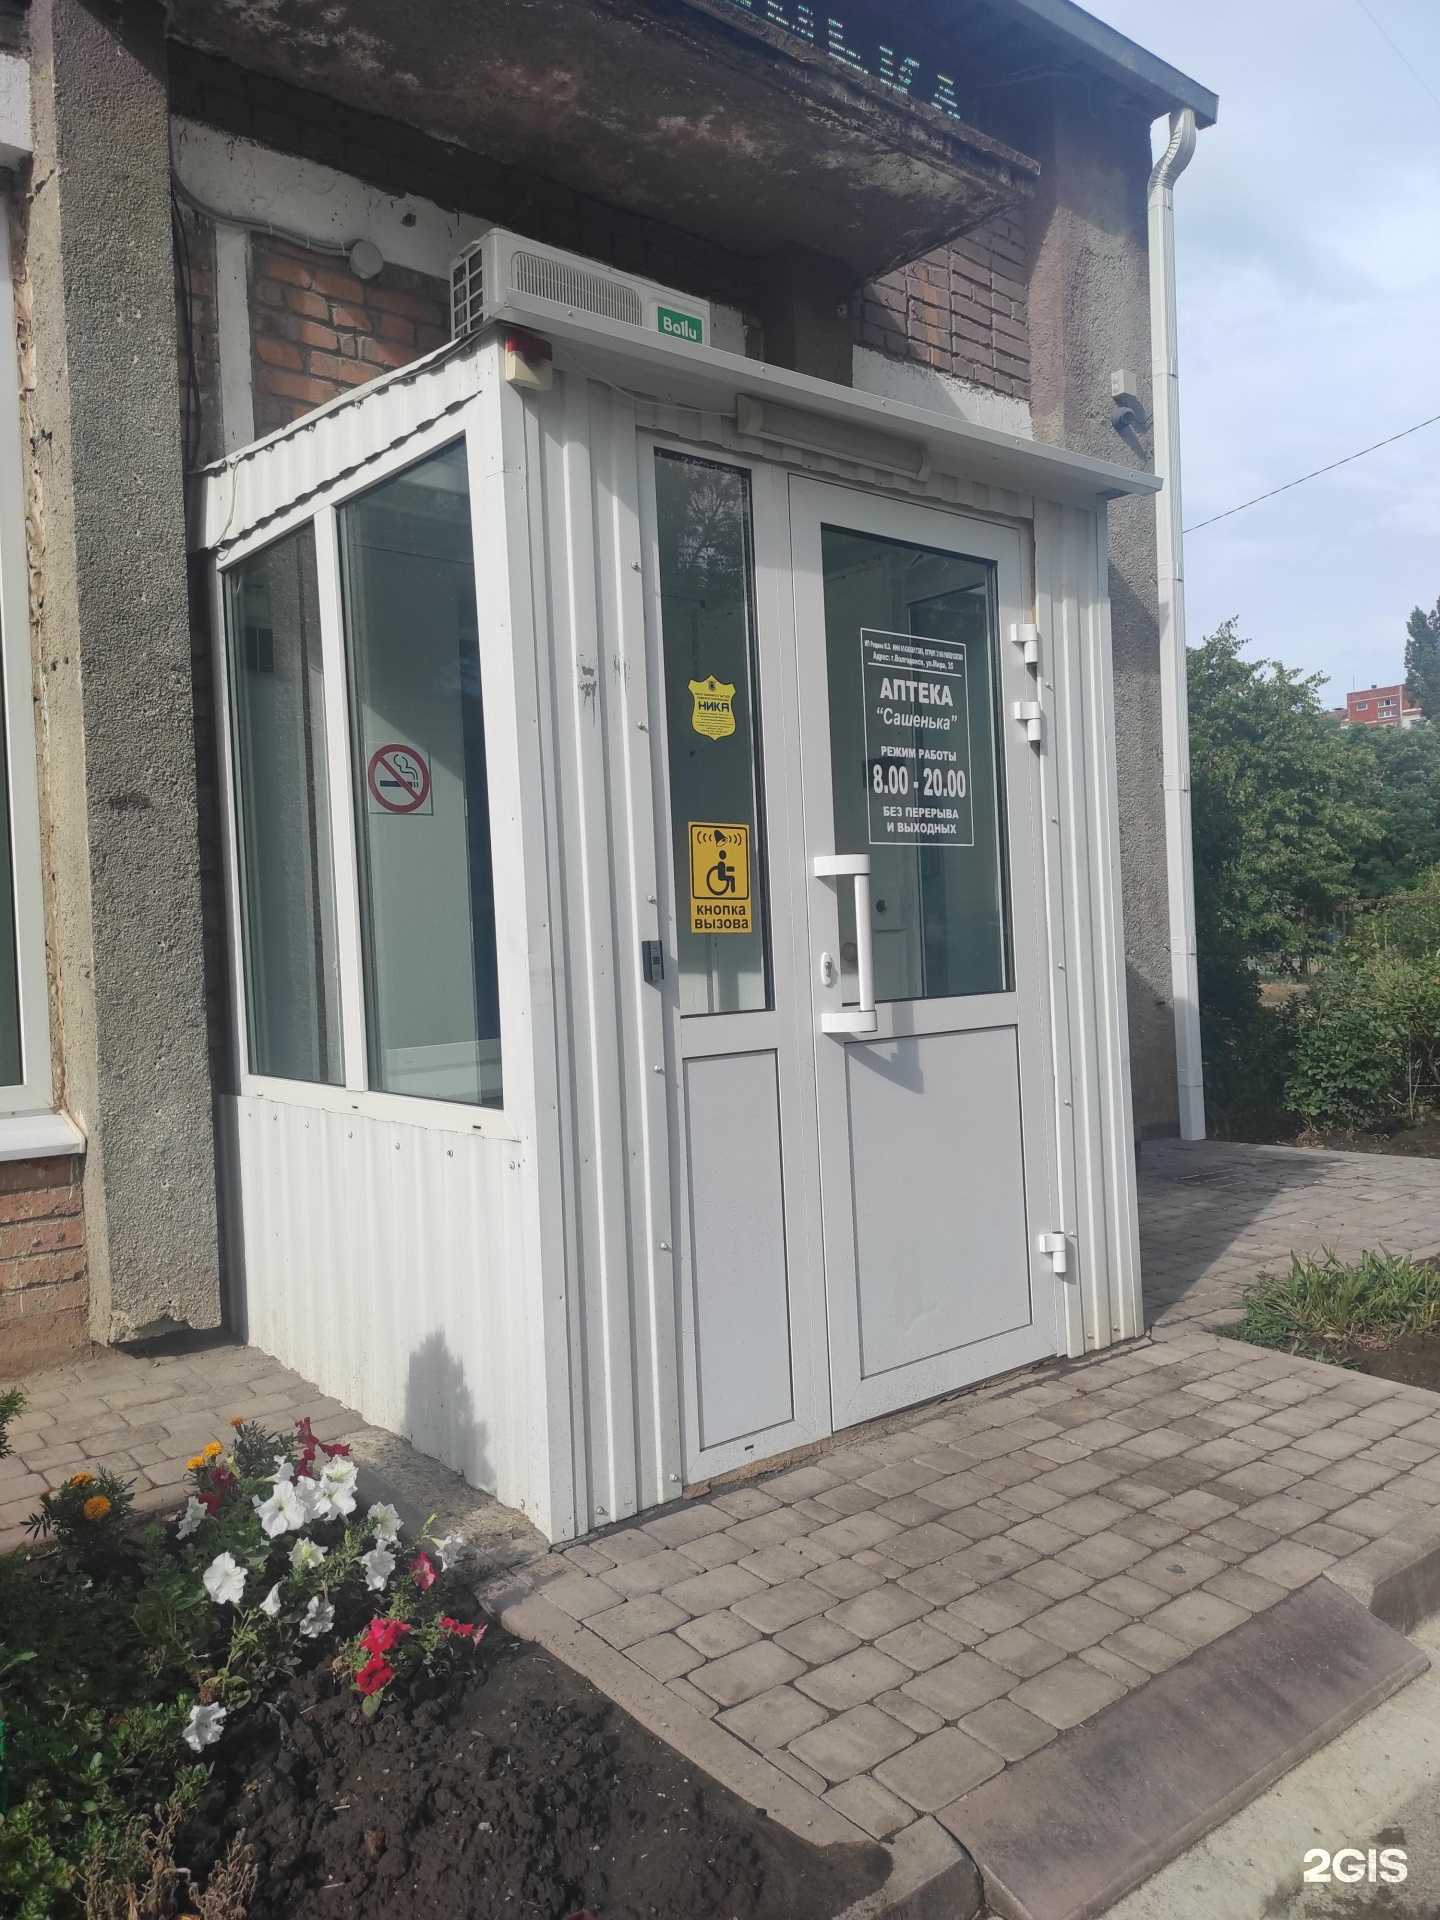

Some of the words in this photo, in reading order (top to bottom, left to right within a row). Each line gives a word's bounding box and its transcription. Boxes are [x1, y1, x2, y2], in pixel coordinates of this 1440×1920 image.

[664, 316, 697, 340] Ballu
[880, 678, 953, 706] АПТЕКА
[698, 700, 730, 712] НИКА
[881, 745, 916, 758] РЕЖИМ
[918, 748, 957, 762] РАБОТЫ
[873, 764, 909, 795] 8.00
[923, 767, 966, 798] 20.00
[883, 805, 902, 817] БЕЗ
[905, 806, 959, 819] ПЕРЕРЫВА
[887, 822, 894, 833] И
[897, 822, 957, 835] ВЫХОДНЫХ
[696, 904, 746, 916] кнопка
[694, 918, 749, 930] вызова
